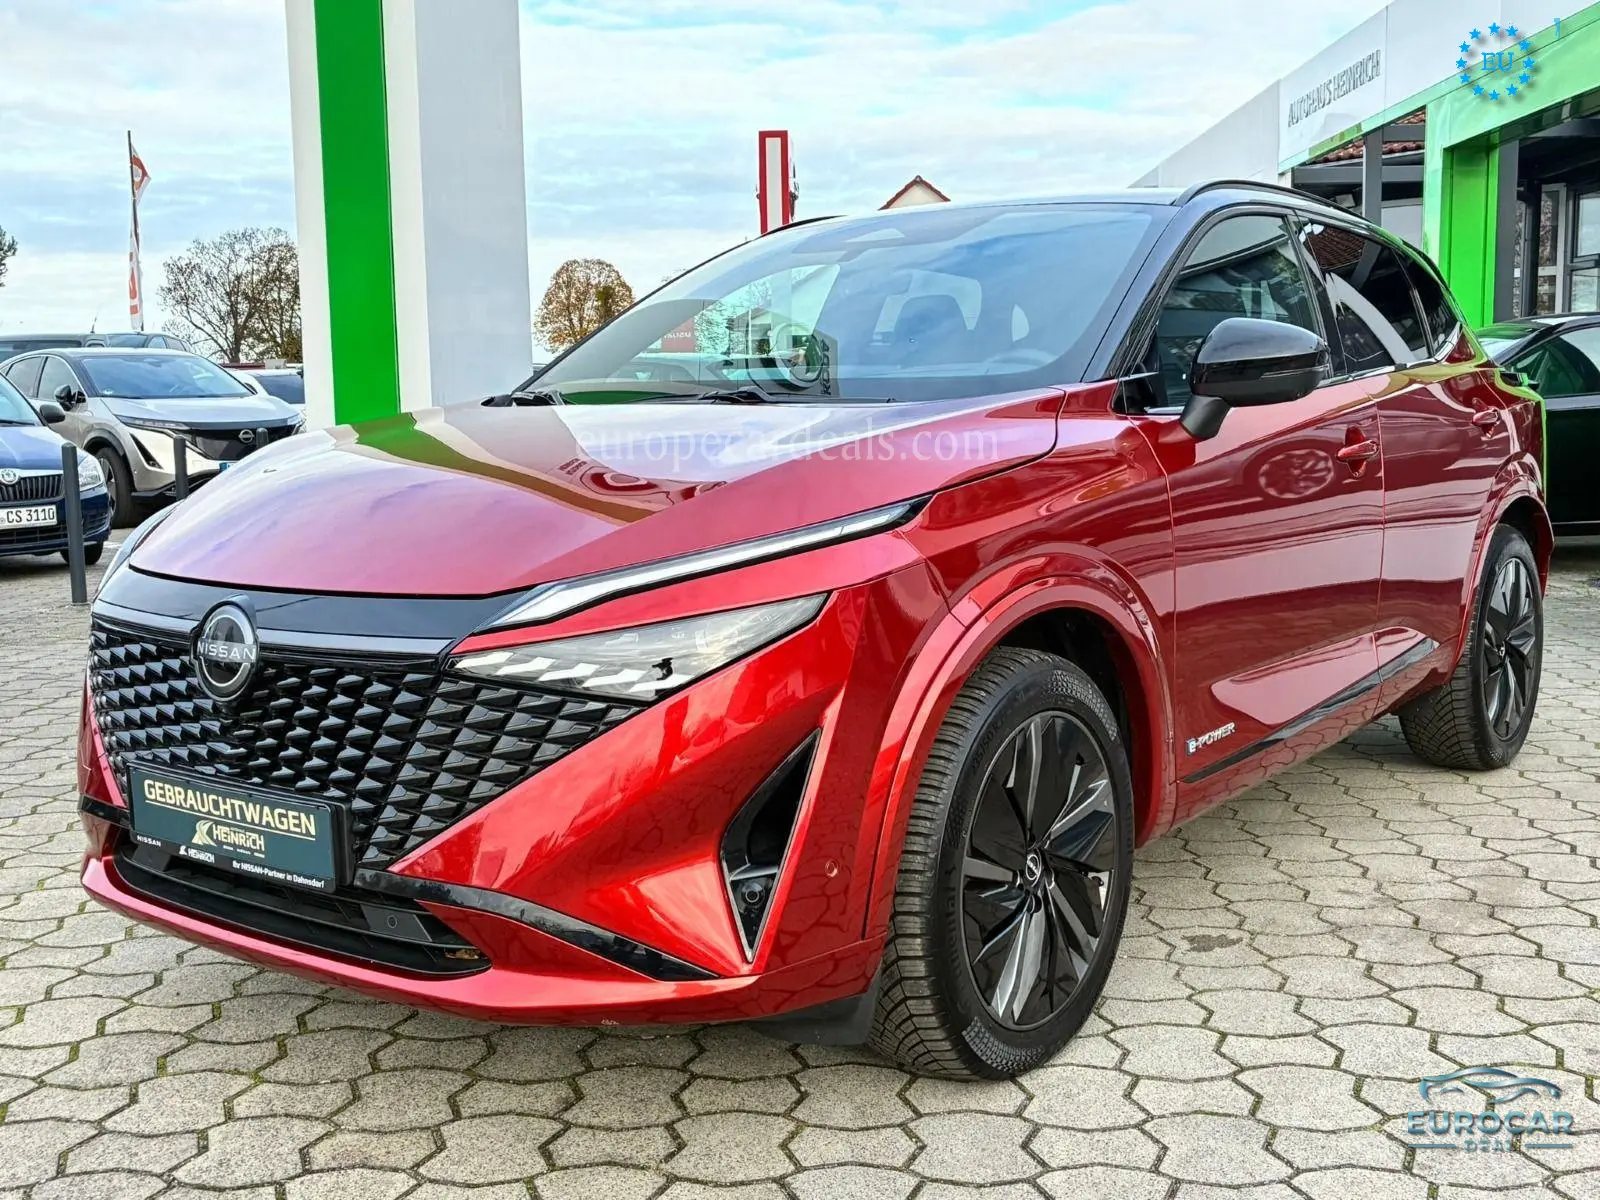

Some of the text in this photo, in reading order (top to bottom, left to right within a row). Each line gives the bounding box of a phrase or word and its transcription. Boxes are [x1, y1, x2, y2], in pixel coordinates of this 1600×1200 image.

[1287, 49, 1381, 127] AUTOHAUS HEINRICH
[6, 507, 55, 523] CS 3110
[197, 641, 256, 662] NISSAN
[143, 778, 316, 836] GEBRAUCHTWAGEN
[136, 835, 162, 847] NISSAN
[241, 863, 285, 879] NISSAN-Partner
